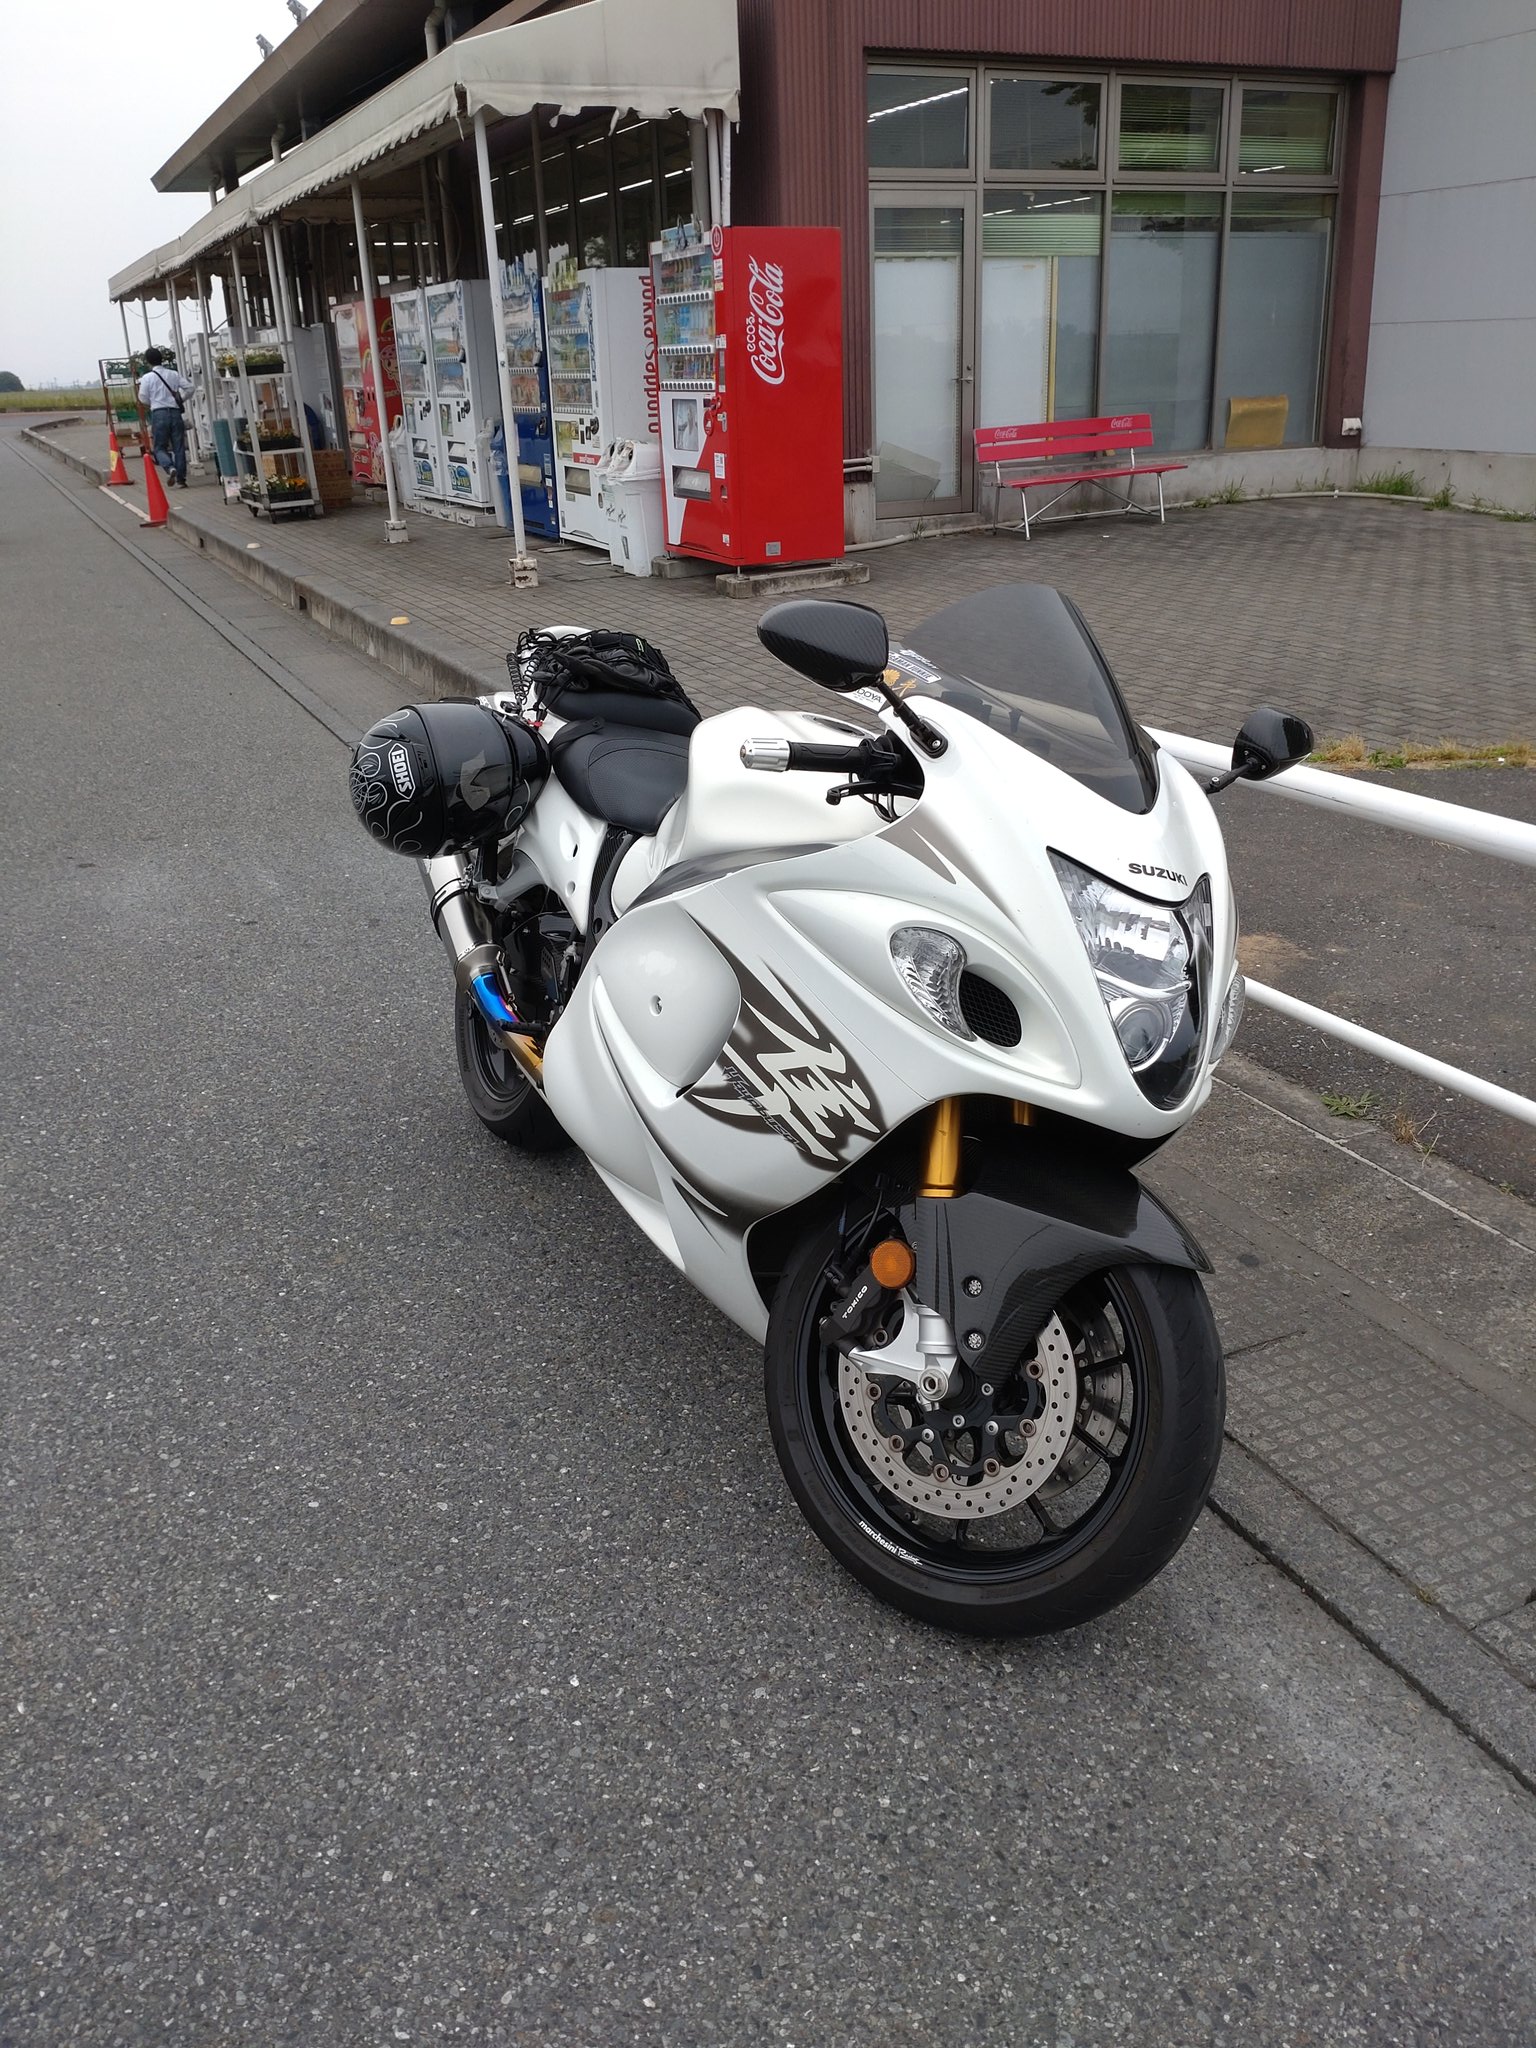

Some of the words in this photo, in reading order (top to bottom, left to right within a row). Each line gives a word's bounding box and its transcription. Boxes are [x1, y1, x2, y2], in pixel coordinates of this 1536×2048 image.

[748, 255, 785, 385] Coca-Cola
[994, 428, 1018, 439] Coca-Cola
[1111, 417, 1133, 429] Coca-Cola
[857, 689, 881, 703] DOYA
[391, 749, 413, 793] SHOEI
[1128, 863, 1189, 887] SUZUKI
[723, 1065, 806, 1152] Hayabusa
[842, 1284, 868, 1320] TOKICO
[858, 1520, 898, 1554] marchesini
